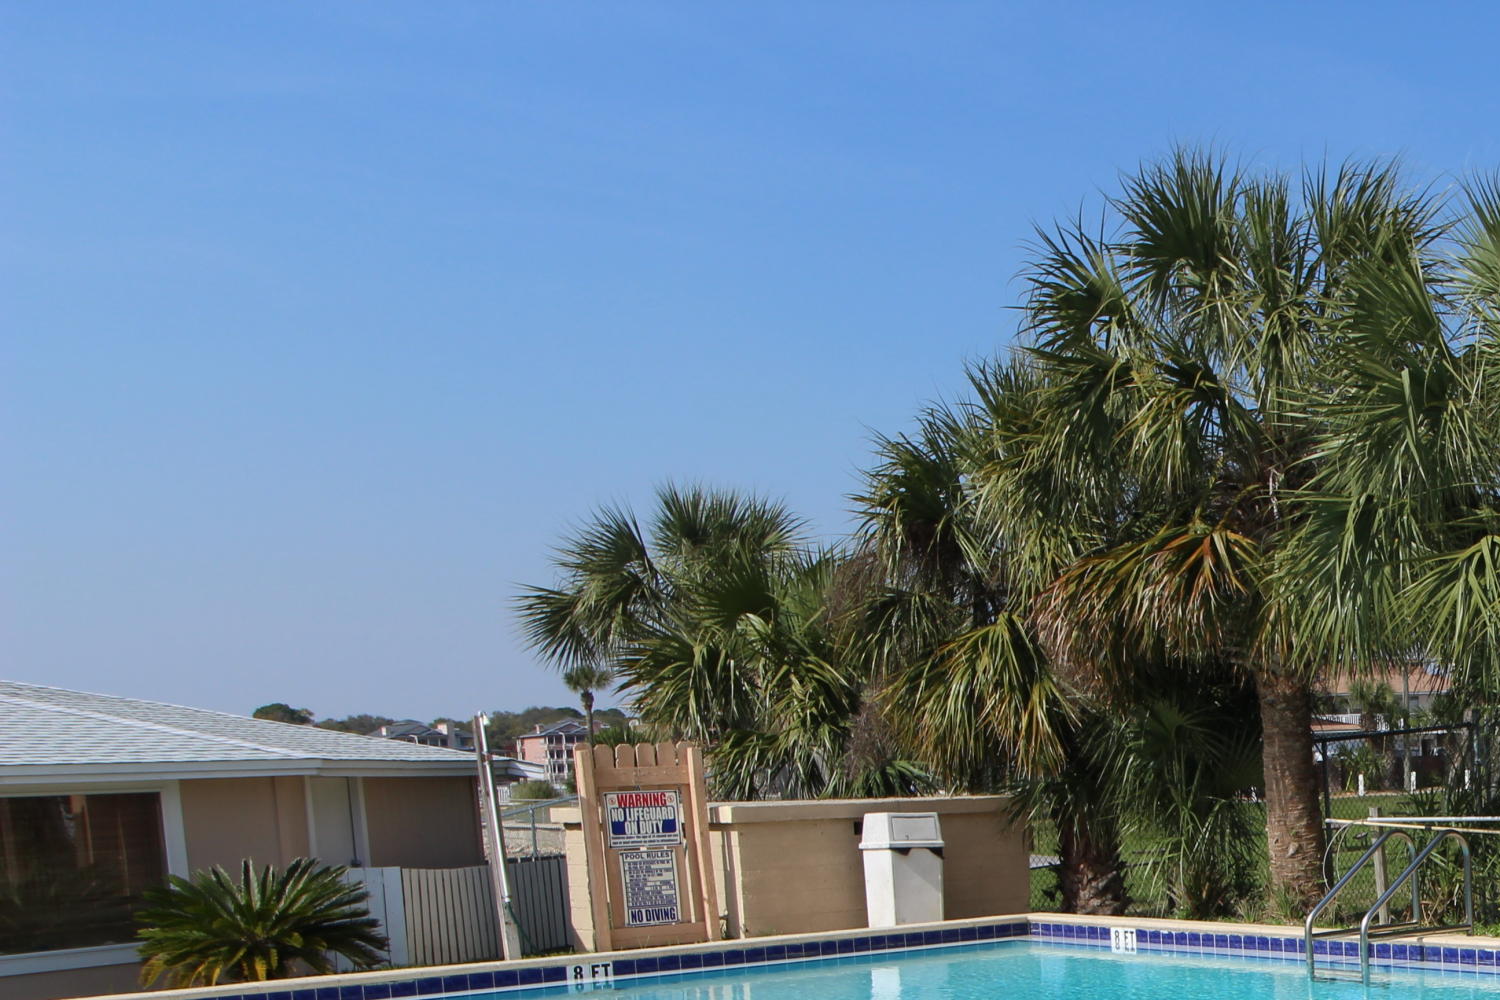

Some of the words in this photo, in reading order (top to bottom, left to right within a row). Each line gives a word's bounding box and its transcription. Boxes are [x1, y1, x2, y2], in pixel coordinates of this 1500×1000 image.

[616, 792, 667, 808] WARNING
[611, 808, 624, 822] NO
[625, 807, 674, 821] LIFEGUARD
[624, 820, 638, 834] ON
[639, 820, 663, 834] DUTY
[646, 851, 670, 859] RULES
[631, 909, 644, 923] NO
[645, 907, 676, 922] DIVING
[573, 965, 584, 980] 8
[591, 963, 611, 979] FT
